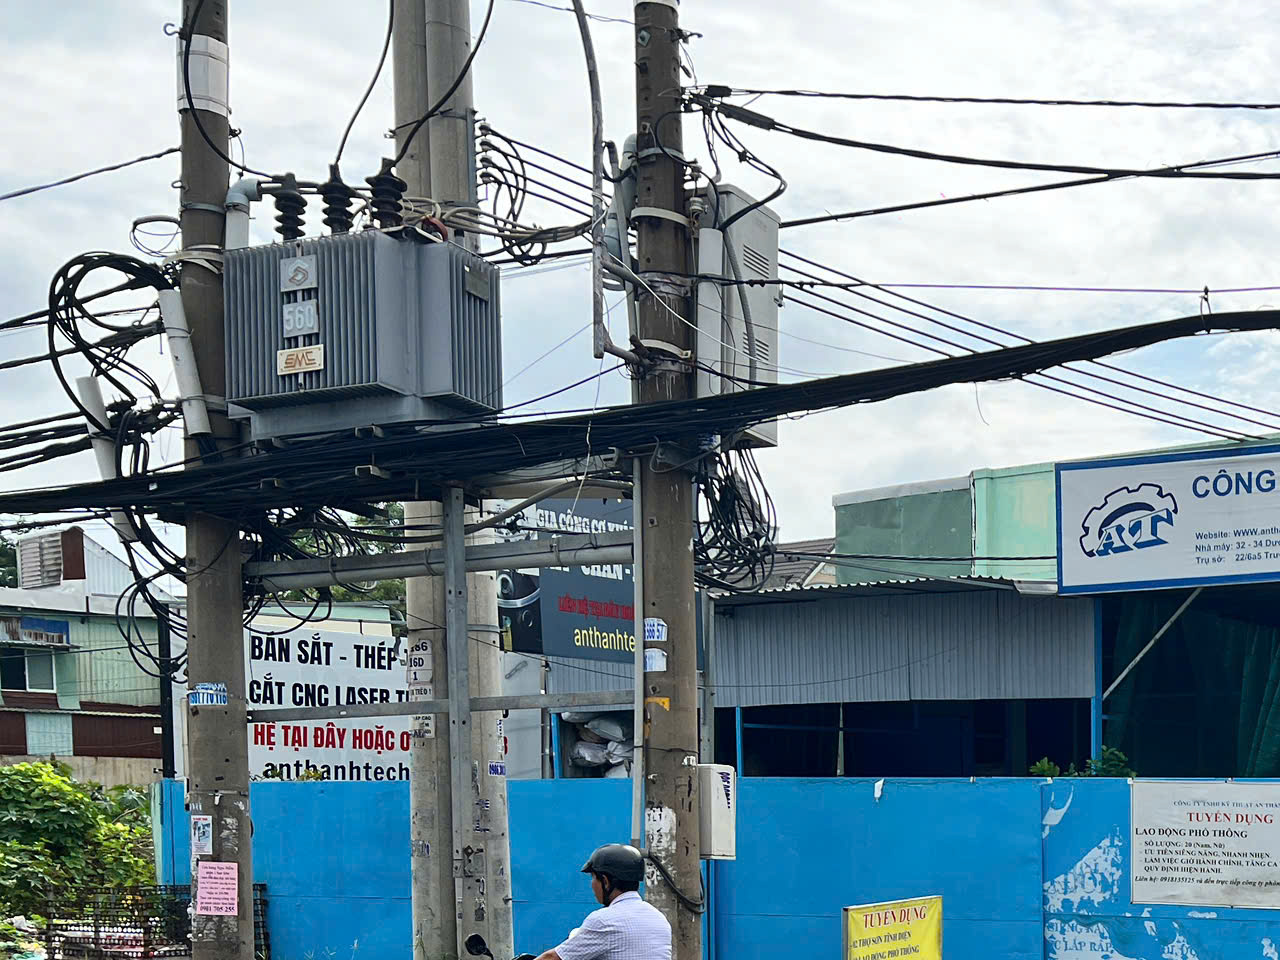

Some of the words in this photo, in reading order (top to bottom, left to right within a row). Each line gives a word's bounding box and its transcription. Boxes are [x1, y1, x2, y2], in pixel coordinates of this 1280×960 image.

[284, 304, 314, 331] 560
[1192, 468, 1276, 499] CÔNG
[1195, 530, 1231, 541] Website:
[1195, 542, 1212, 553] Nhà
[1213, 541, 1234, 553] máy:
[1235, 540, 1247, 550] 32
[1252, 539, 1263, 549] 34
[1196, 555, 1210, 566] Trụ
[297, 632, 333, 666] SẮT
[291, 682, 329, 707] CNC
[281, 725, 308, 751] TẠI
[313, 722, 347, 749] ĐÂY
[352, 725, 395, 755] HOẶC
[1235, 813, 1274, 826] DỤNG
[1135, 827, 1156, 836] LAO
[1158, 828, 1186, 838] ĐỘNG
[1212, 827, 1248, 839] THÔNG
[1144, 865, 1160, 873] QUY
